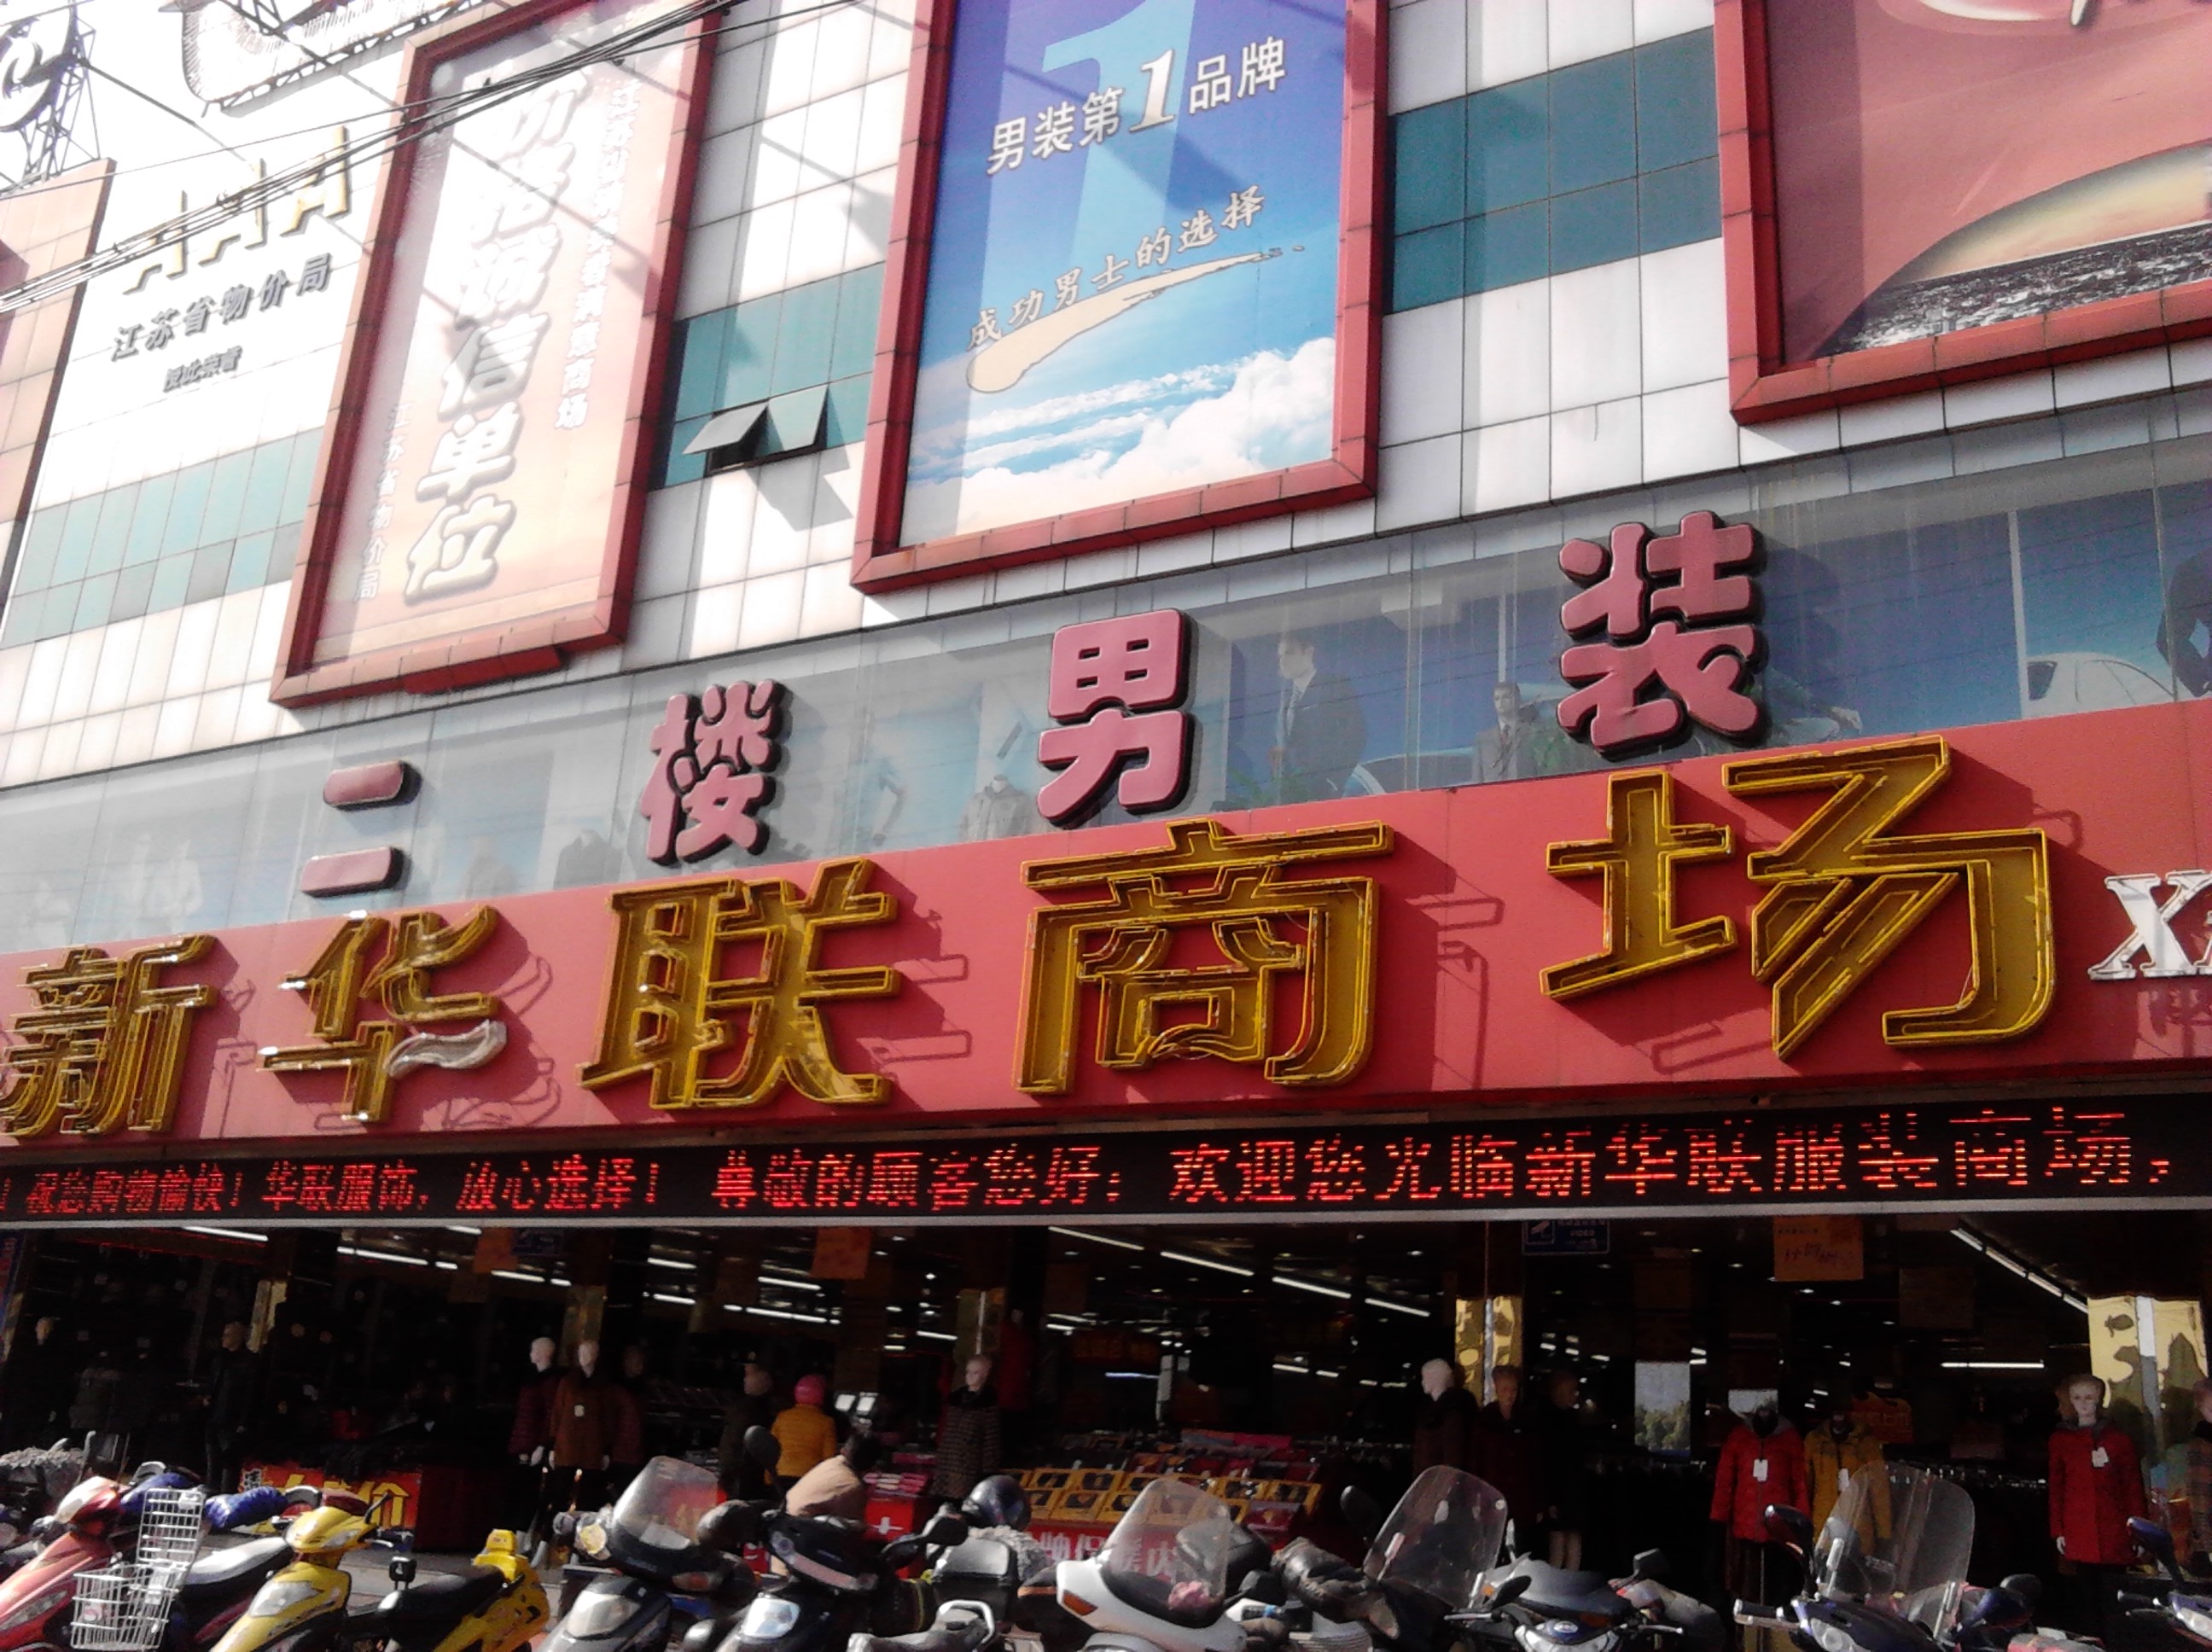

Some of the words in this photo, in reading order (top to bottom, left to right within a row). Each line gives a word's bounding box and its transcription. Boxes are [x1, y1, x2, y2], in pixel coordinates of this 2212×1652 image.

[986, 36, 1286, 175] 男装第1品牌
[111, 252, 331, 362] 江苏省物价局
[966, 184, 1265, 352] 成功男士的选择
[301, 510, 1767, 897] 二楼男装
[0, 735, 2055, 1137] 新华联商场
